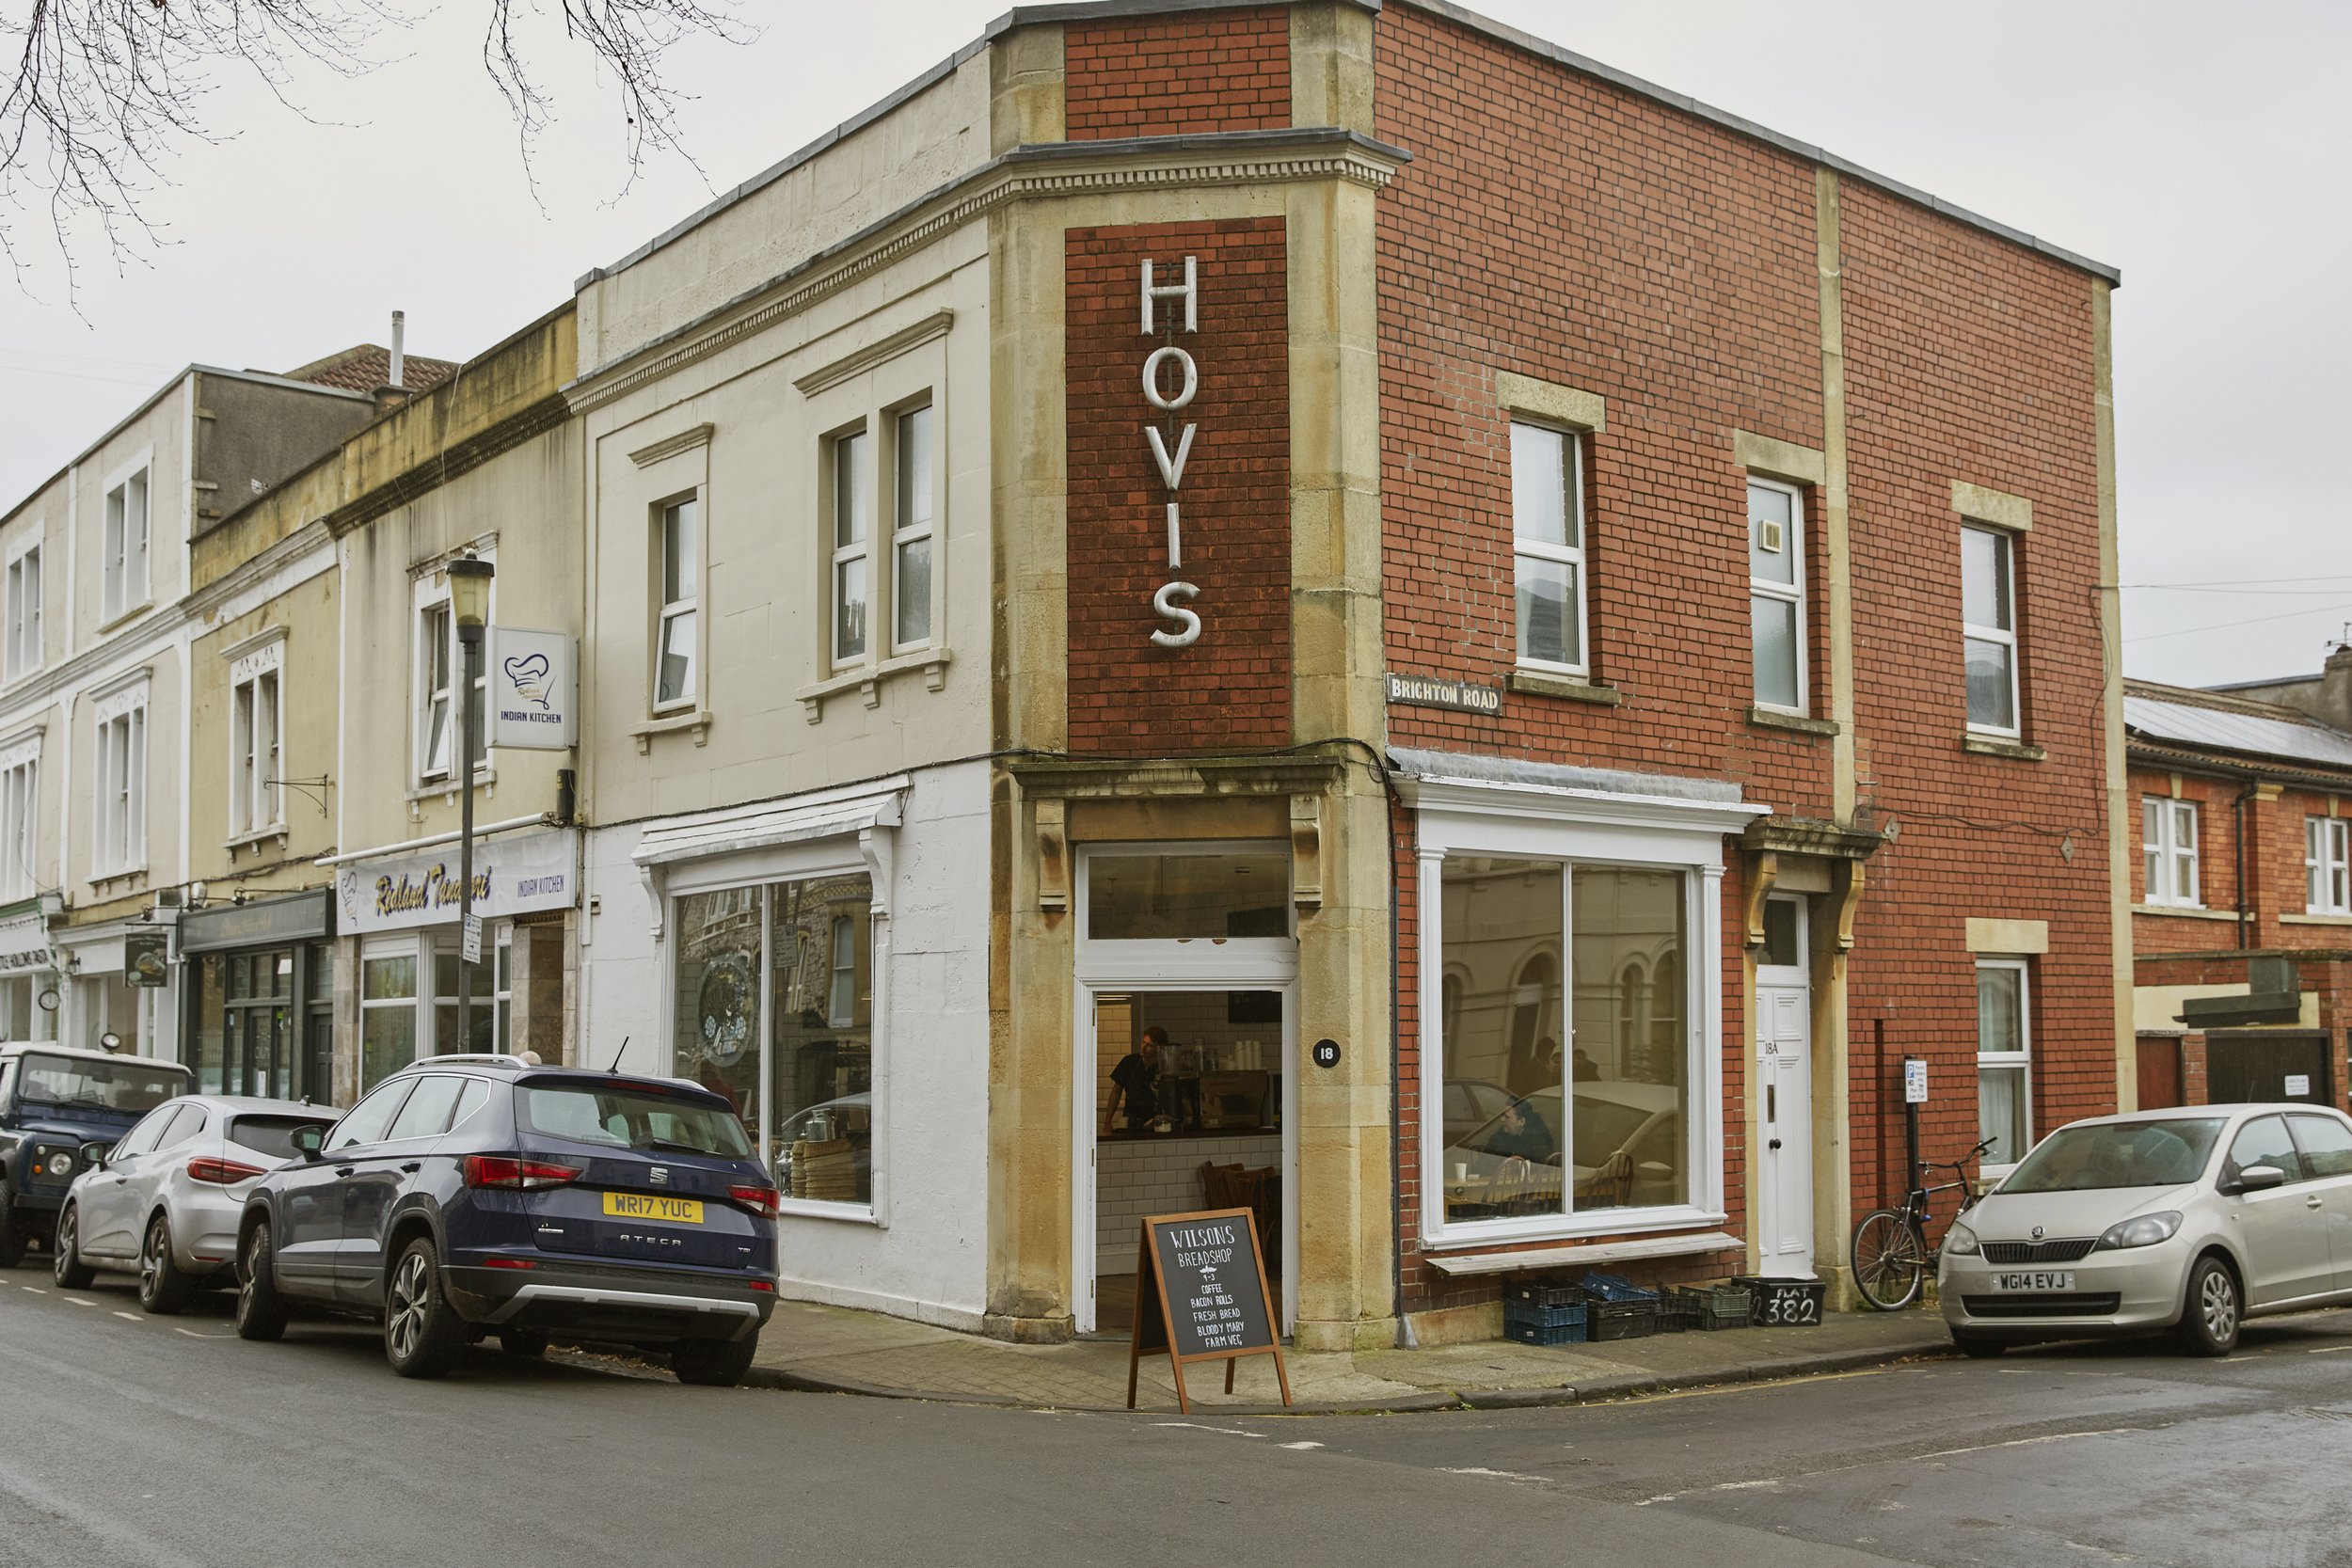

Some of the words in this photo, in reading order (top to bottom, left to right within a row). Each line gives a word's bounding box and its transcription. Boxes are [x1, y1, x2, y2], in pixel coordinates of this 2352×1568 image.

[1140, 255, 1201, 649] HOVIS
[1391, 678, 1458, 704] BRIGHTON
[1463, 688, 1499, 709] ROAD
[501, 710, 528, 721] INDIAN
[529, 712, 562, 724] KITCHEN
[375, 870, 429, 916] Redland
[430, 863, 492, 910] Tanori
[517, 878, 538, 897] INDIAN
[538, 874, 564, 895] KITCHEN
[1321, 1048, 1333, 1059] 18
[1765, 1041, 1778, 1054] 18A
[614, 1195, 655, 1214] WR17
[659, 1198, 692, 1219] YUC
[620, 1234, 682, 1246] ATECA
[1169, 1226, 1235, 1248] WILSONS
[1177, 1247, 1232, 1267] BREADSHOP
[1200, 1283, 1223, 1294] COFFEE
[2000, 1275, 2031, 1289] WG14
[2035, 1273, 2065, 1289] EVJ
[1190, 1296, 1214, 1308] BACON
[1215, 1294, 1233, 1306] ROLLS
[1776, 1288, 1810, 1299] FLAT
[1193, 1310, 1217, 1323] FRESH
[1218, 1307, 1241, 1320] BREAD
[1768, 1298, 1818, 1323] 382
[1197, 1323, 1224, 1337] BLOODY
[1225, 1321, 1245, 1333] MARY
[1204, 1336, 1228, 1348] FARM
[1227, 1334, 1243, 1346] VEG
